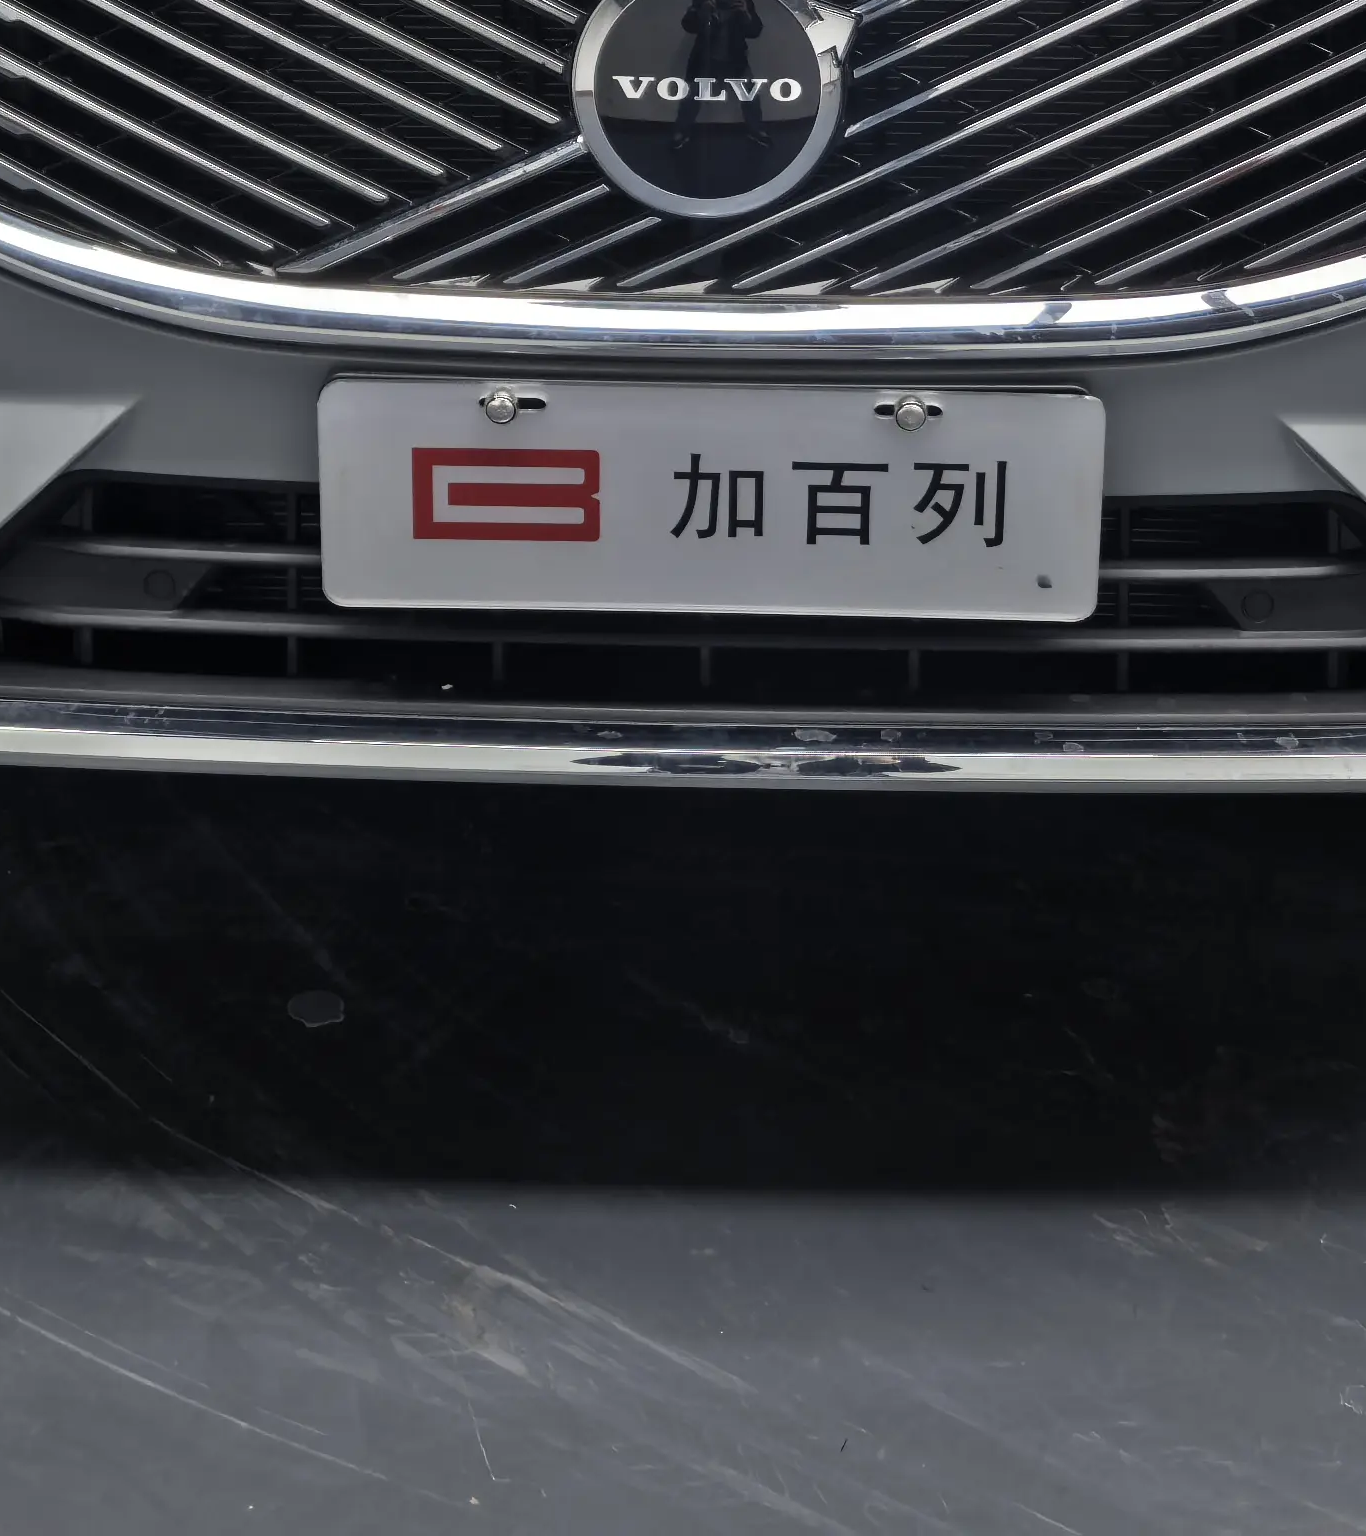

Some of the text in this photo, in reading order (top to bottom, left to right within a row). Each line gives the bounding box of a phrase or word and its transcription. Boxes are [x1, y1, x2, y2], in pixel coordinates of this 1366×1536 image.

[612, 75, 803, 103] VOLVO
[670, 452, 1009, 549] 加百列
